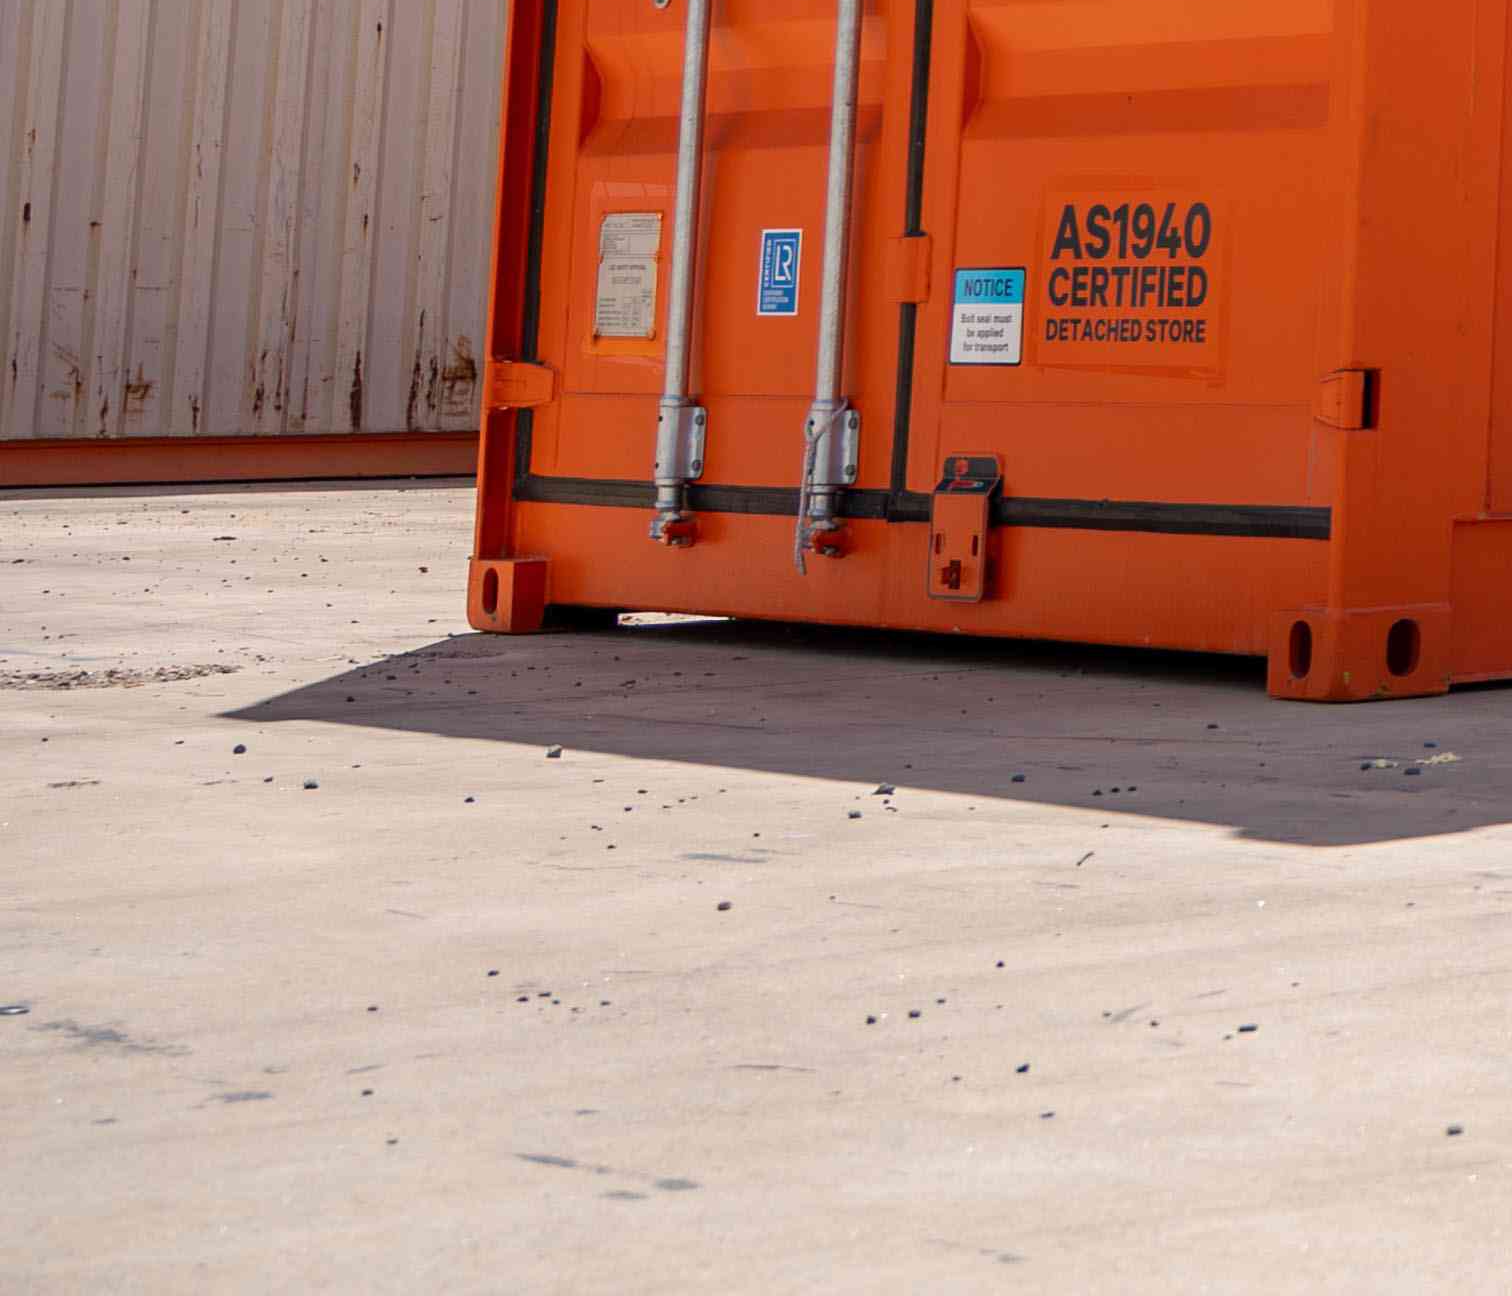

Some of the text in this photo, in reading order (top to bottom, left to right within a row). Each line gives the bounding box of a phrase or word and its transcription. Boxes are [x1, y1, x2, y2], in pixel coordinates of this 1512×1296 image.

[1051, 202, 1211, 259] AS1940
[964, 279, 1013, 297] NOTICE
[1049, 266, 1208, 308] CERTIFIED
[1046, 318, 1206, 343] DETACHED STORE
